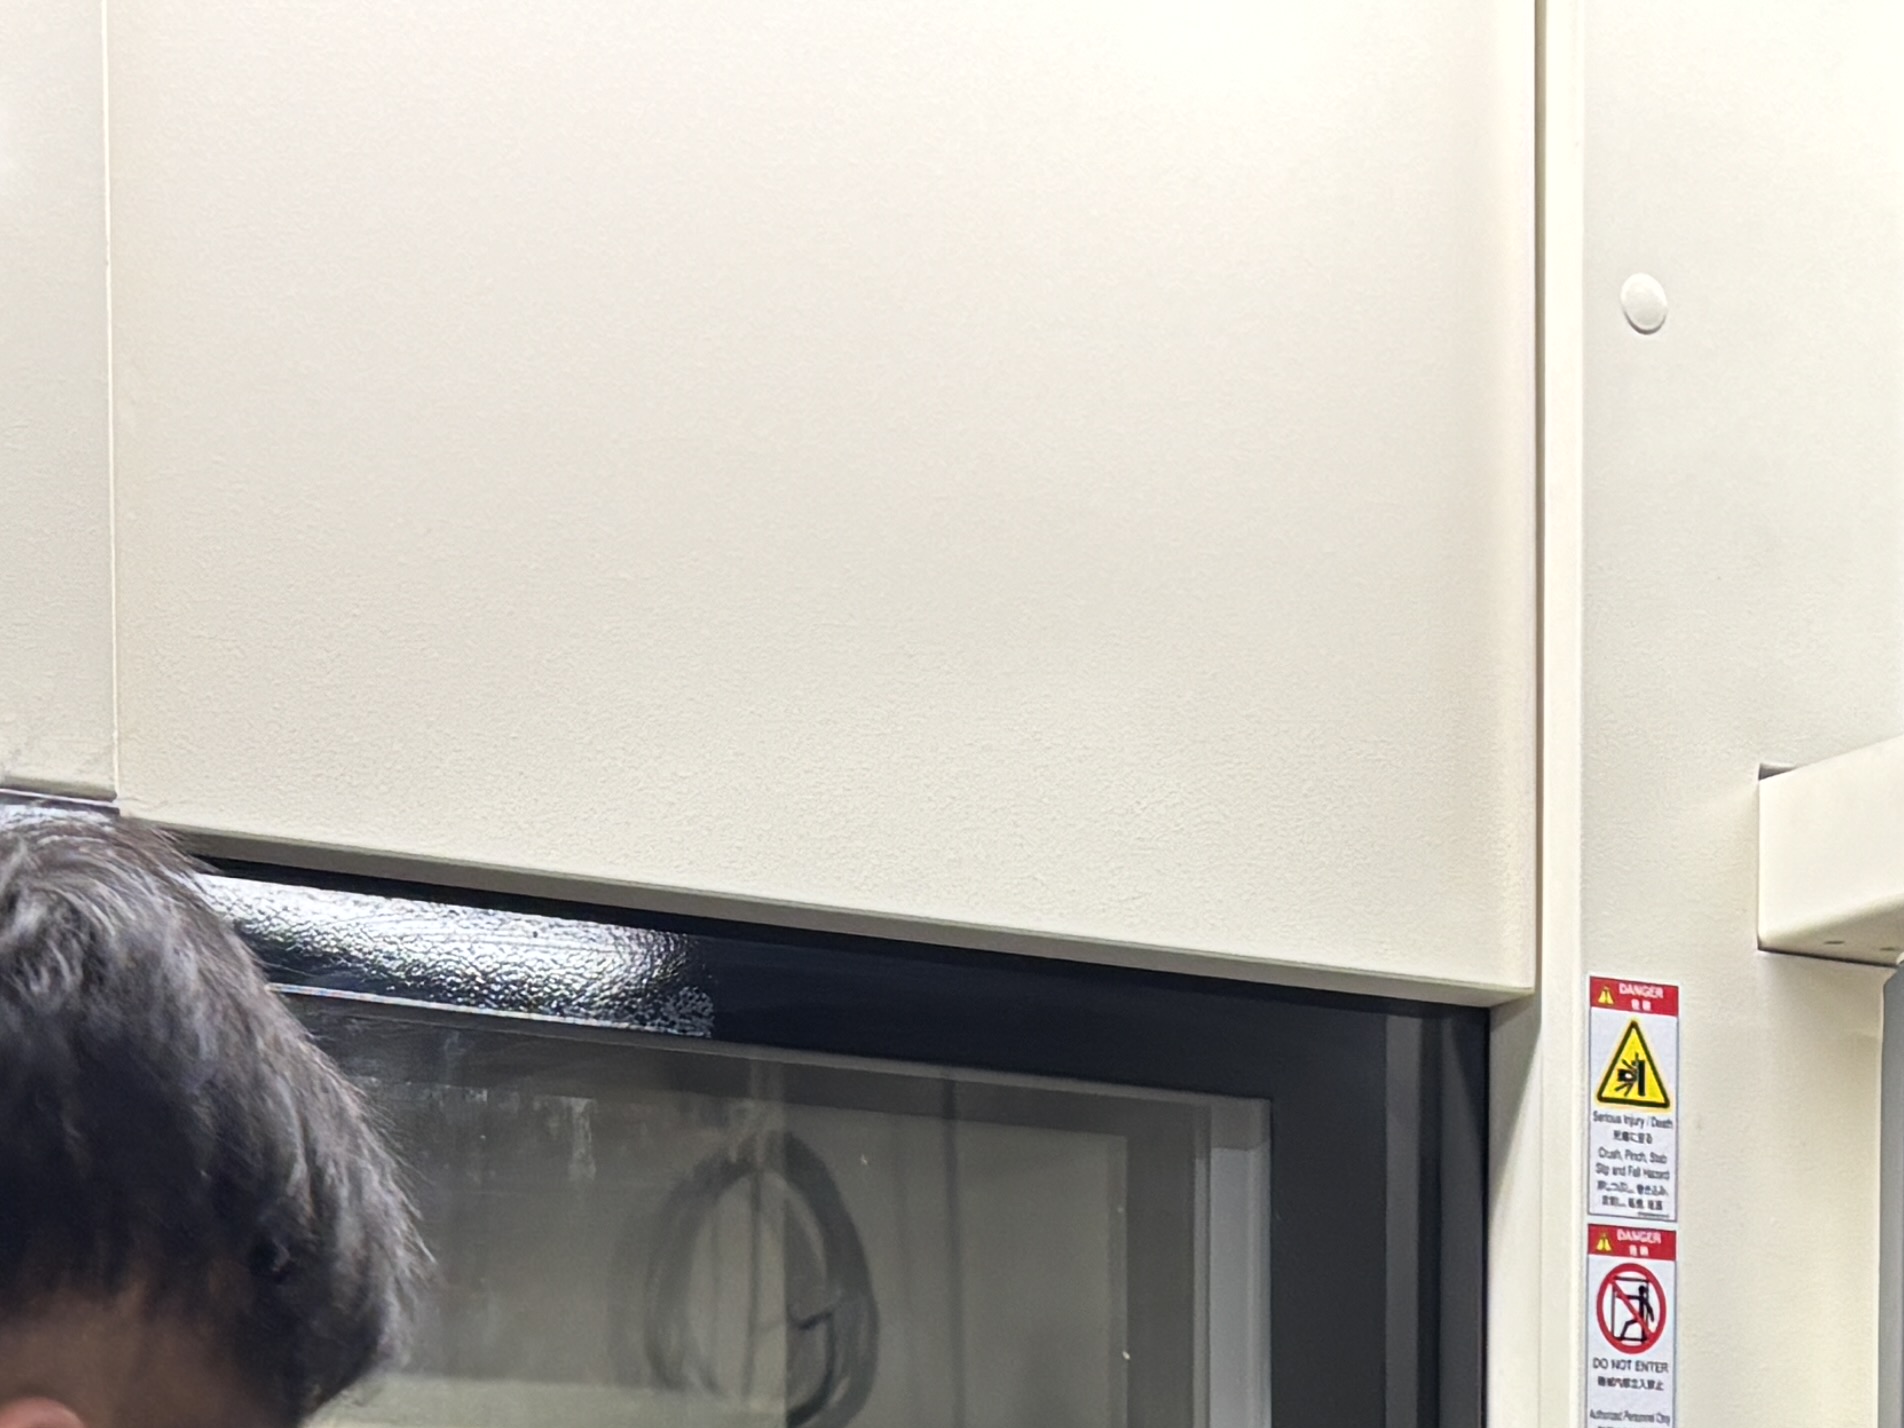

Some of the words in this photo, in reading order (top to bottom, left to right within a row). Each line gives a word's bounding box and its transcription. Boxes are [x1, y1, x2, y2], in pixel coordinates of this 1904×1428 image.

[1619, 983, 1663, 996] DANGER
[1616, 1229, 1661, 1242] DANGER
[1592, 1358, 1608, 1368] DO
[1611, 1359, 1631, 1370] NOT
[1635, 1361, 1669, 1372] ENTER
